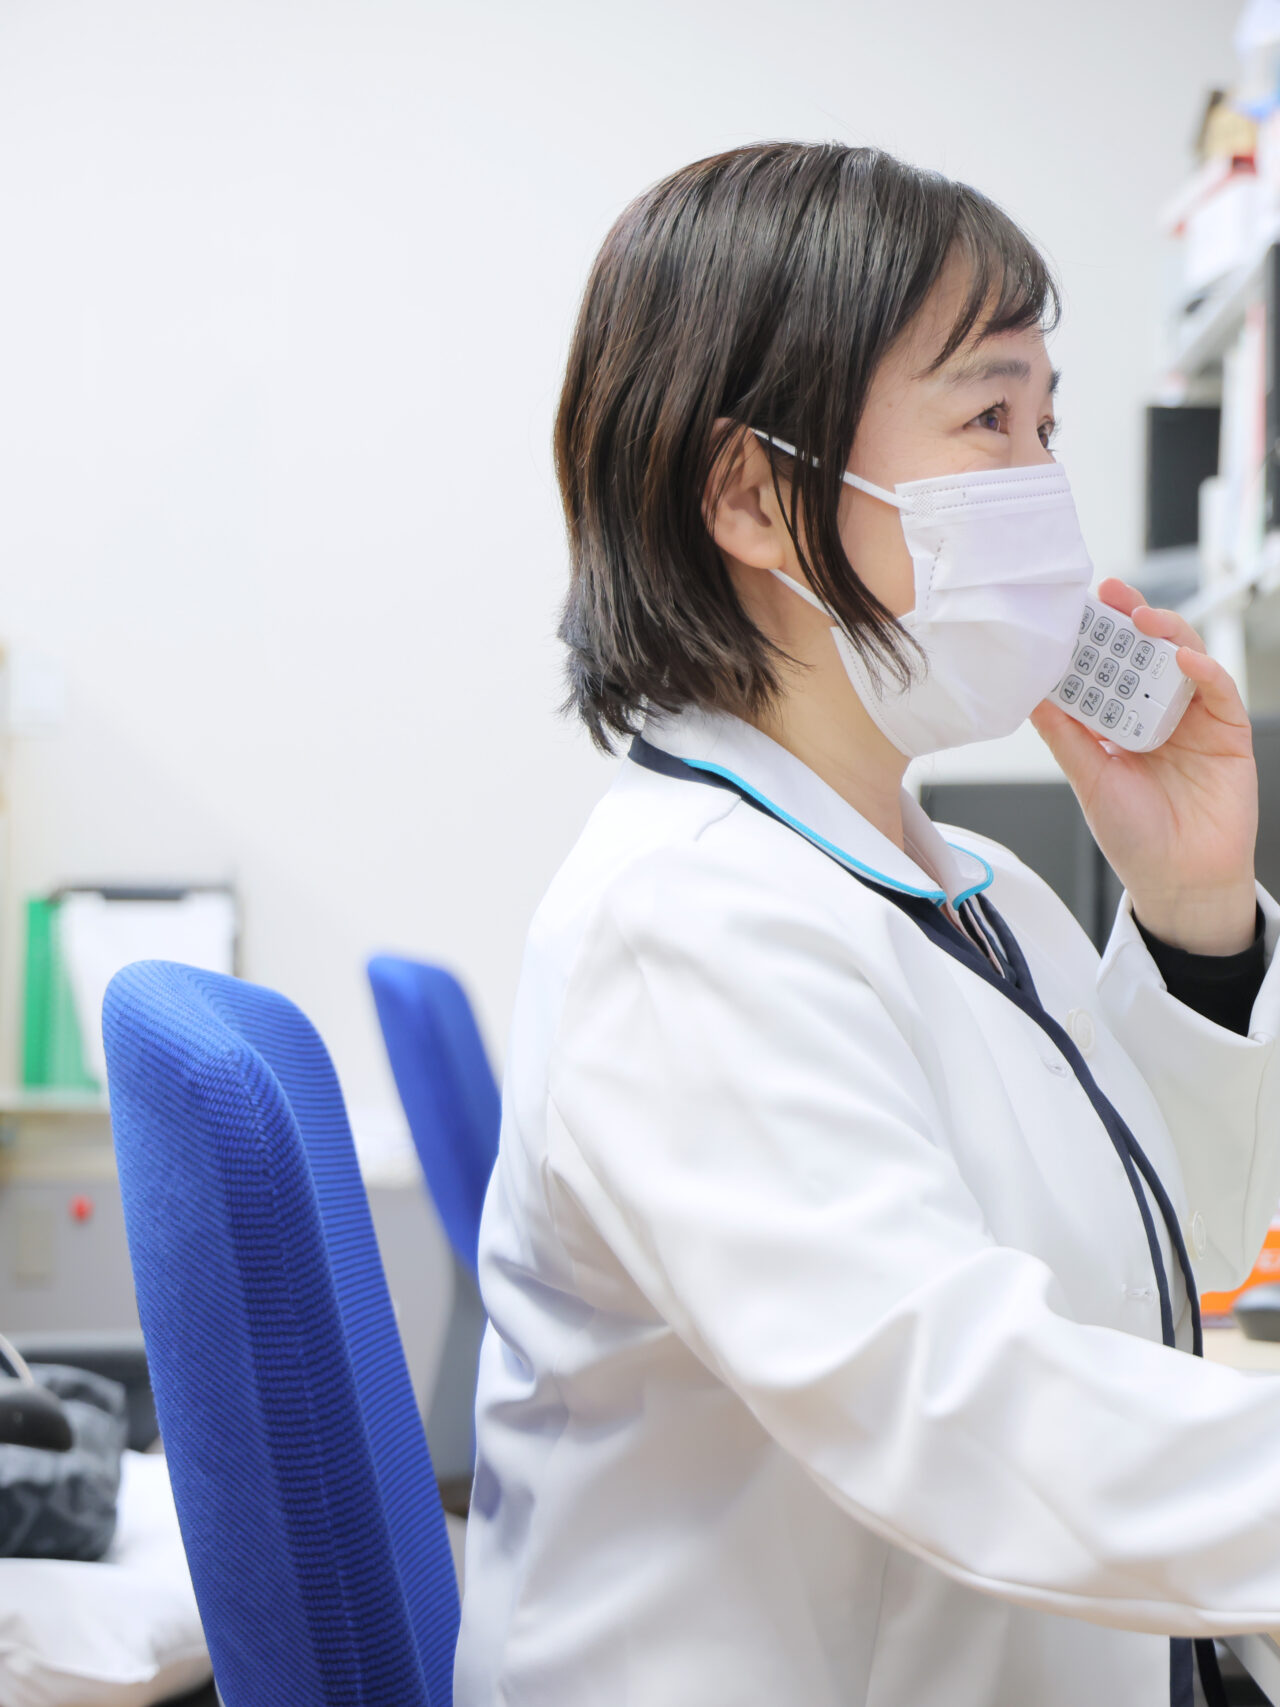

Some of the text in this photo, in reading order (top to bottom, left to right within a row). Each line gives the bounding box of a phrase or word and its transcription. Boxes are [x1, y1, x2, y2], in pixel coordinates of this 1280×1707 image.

[1093, 630, 1106, 642] 6
[1113, 642, 1126, 654] 9
[1077, 658, 1090, 671] 5
[1134, 652, 1147, 666] #
[1097, 671, 1110, 684] 8
[1063, 687, 1076, 700] 4
[1117, 683, 1131, 696] 0
[1081, 699, 1094, 712] 7
